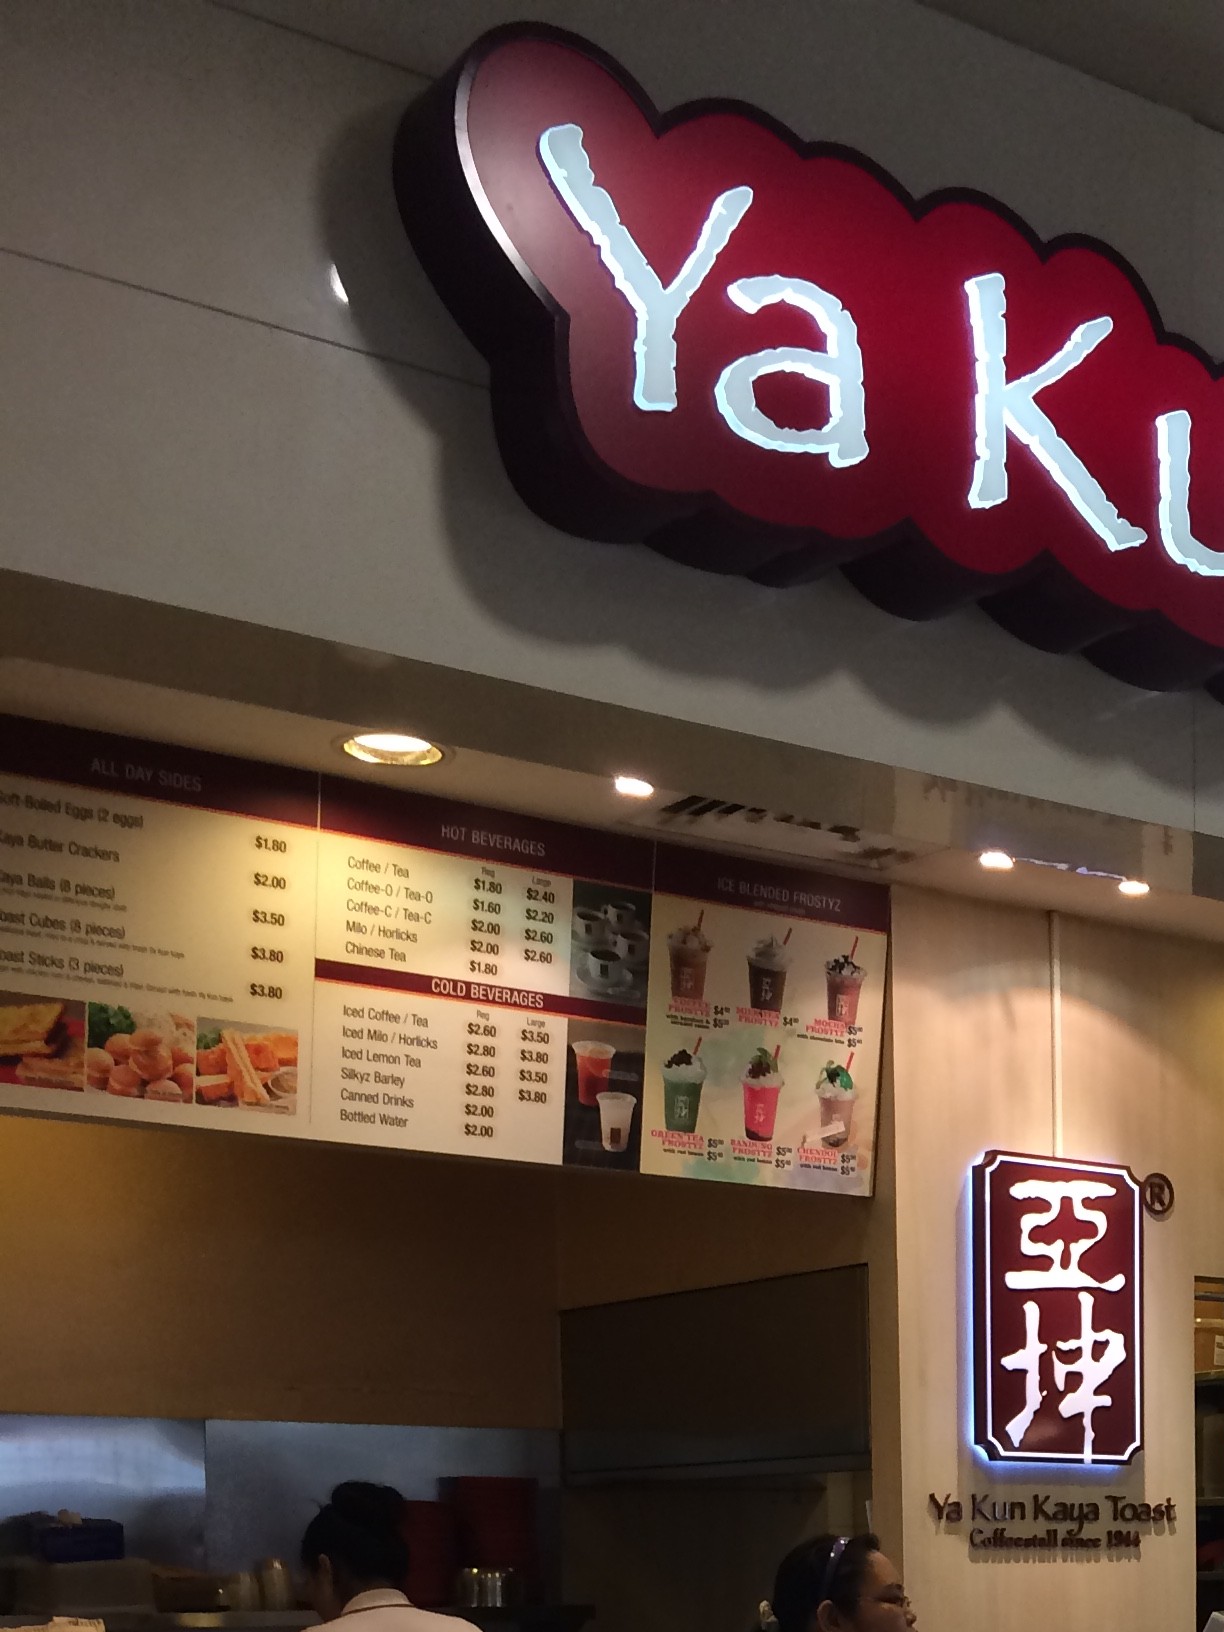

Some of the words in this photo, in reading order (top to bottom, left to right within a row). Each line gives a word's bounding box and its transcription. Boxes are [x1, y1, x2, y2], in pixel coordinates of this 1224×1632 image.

[539, 123, 868, 468] Ya
[91, 758, 118, 778] ALL
[125, 764, 153, 783] DAY
[158, 770, 201, 791] SIDES
[65, 802, 94, 820] Eggs
[112, 812, 144, 829] eggs)
[27, 834, 63, 852] Butter
[68, 841, 120, 863] Crackers
[255, 835, 287, 853] $1.80
[441, 824, 466, 841] HOT
[472, 830, 546, 857] BEVERAGES
[348, 855, 381, 874] Coffee
[392, 863, 409, 879] Tea
[481, 866, 495, 878] Reg
[27, 873, 56, 891] Balls
[75, 882, 115, 901] pieces)
[253, 872, 286, 890] $2.00
[474, 878, 502, 895] $1.80
[532, 875, 552, 887] Large
[347, 877, 393, 897] Coffee-O
[404, 887, 433, 904] Tea-O
[526, 887, 555, 905] $2.40
[718, 876, 734, 894] ICE
[739, 881, 790, 902] BLENDED
[794, 893, 841, 913] FROSTYZ
[347, 899, 392, 918] Coffee-C
[402, 908, 432, 925] Tea-C
[473, 899, 501, 915] $1.60
[252, 909, 285, 927] $3.50
[525, 908, 554, 925] $2.20
[29, 913, 66, 931] Cubes
[85, 923, 125, 941] pieces)
[346, 920, 367, 935] Milo
[378, 926, 418, 943] Horlicks
[471, 919, 501, 936] $2.00
[524, 929, 553, 945] $2.60
[251, 946, 284, 963] $3.80
[345, 941, 385, 959] Chinese
[389, 948, 407, 963] Tea
[470, 939, 499, 956] $2.00
[28, 951, 65, 970] Sticks
[84, 960, 124, 978] pieces)
[524, 949, 553, 965] $2.60
[469, 960, 498, 976] $1.80
[250, 983, 282, 1000] $3.80
[431, 978, 466, 997] COLD
[470, 984, 544, 1009] BEVERAGES
[343, 1005, 365, 1019] Iced
[368, 1007, 400, 1024] Coffee
[412, 1014, 429, 1028] Tea
[476, 1009, 490, 1022] Reg
[527, 1017, 546, 1029] Large
[342, 1026, 364, 1040] Iced
[367, 1028, 388, 1043] Milo
[399, 1033, 438, 1050] Horlicks
[467, 1022, 497, 1038] $2.60
[521, 1029, 550, 1045] $3.50
[342, 1046, 363, 1060] Iced
[366, 1049, 400, 1065] Lemon
[404, 1054, 422, 1068] Tea
[466, 1043, 496, 1058] $2.80
[520, 1049, 549, 1064] $3.80
[341, 1068, 370, 1083] Silkyz
[374, 1072, 405, 1089] Barley
[466, 1063, 495, 1078] $2.60
[519, 1069, 548, 1084] $3.50
[341, 1088, 379, 1105] Canned
[383, 1093, 414, 1109] Drinks
[465, 1083, 495, 1098] $2.80
[518, 1089, 547, 1104] $3.80
[340, 1109, 375, 1125] Bottled
[379, 1113, 408, 1128] Water
[465, 1103, 494, 1118] $2.00
[464, 1123, 493, 1138] $2.00
[929, 1493, 963, 1522] Ya
[971, 1493, 1026, 1522] Kun
[1033, 1493, 1099, 1535] Kaya
[1107, 1495, 1177, 1522] Toast
[1061, 1532, 1101, 1549] since
[1106, 1530, 1141, 1548] 1944
